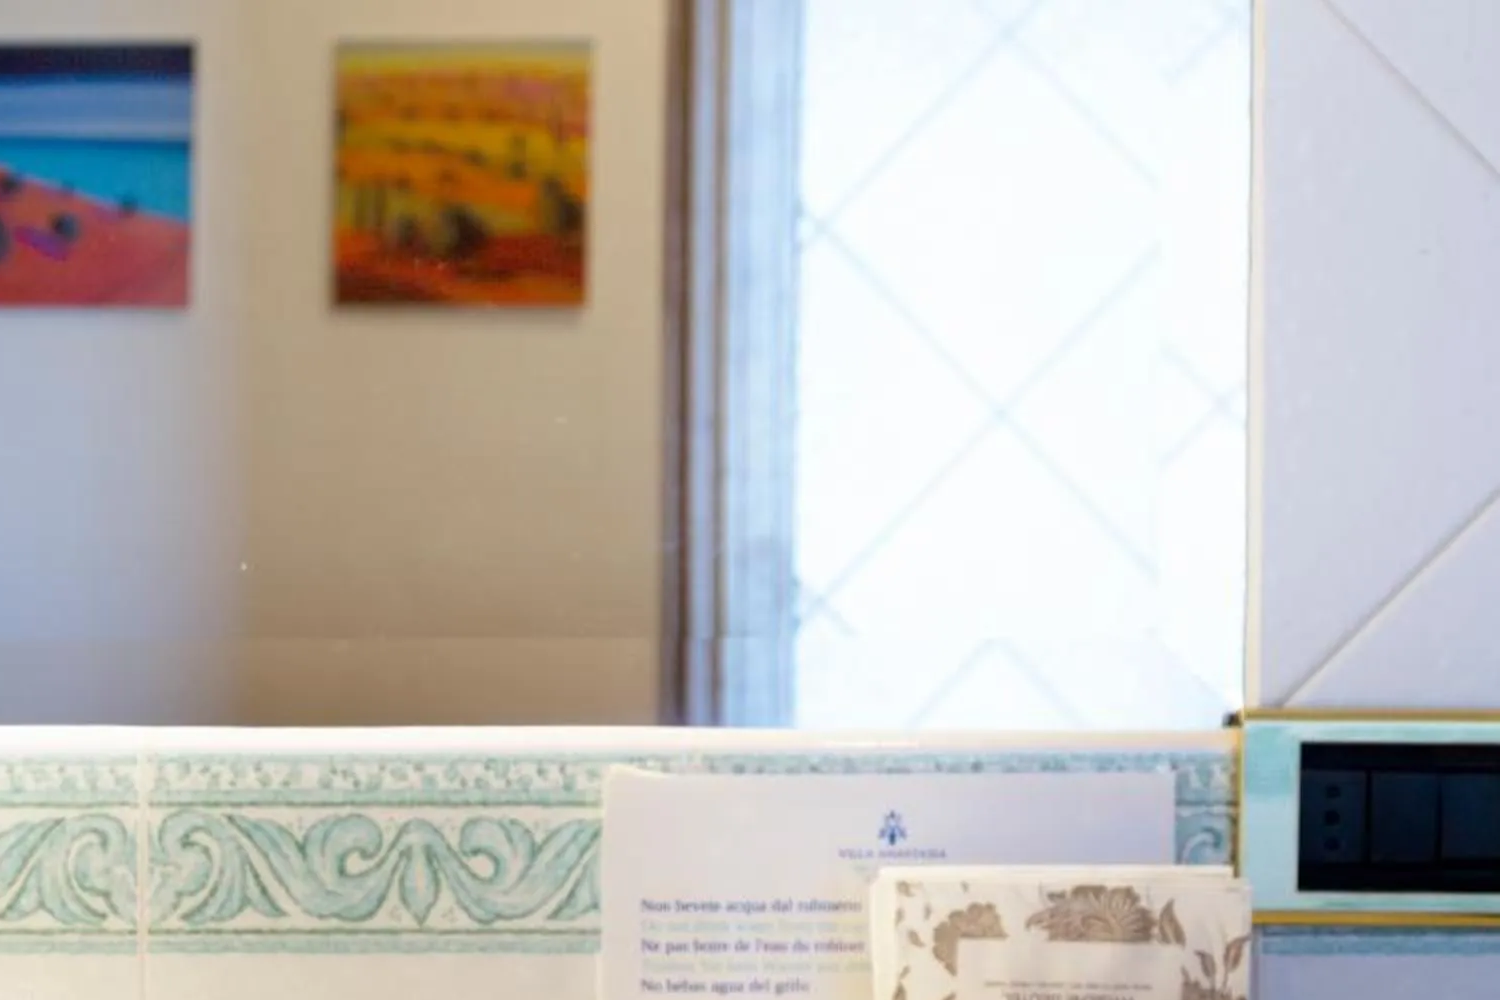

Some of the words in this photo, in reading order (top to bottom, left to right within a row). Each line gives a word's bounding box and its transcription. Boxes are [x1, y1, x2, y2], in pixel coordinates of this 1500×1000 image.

[640, 898, 671, 912] Non
[674, 898, 721, 912] bevete
[725, 900, 767, 916] acqua
[771, 897, 793, 912] dal
[640, 938, 660, 953] Ne
[665, 941, 690, 956] pas
[733, 938, 751, 953] de
[755, 938, 789, 953] l'eau
[792, 938, 810, 953] du
[814, 938, 865, 953] robinet
[640, 979, 663, 993] No
[666, 979, 706, 993] bebas
[711, 982, 745, 996] agua
[748, 978, 771, 993] del
[774, 978, 810, 996] grifo
